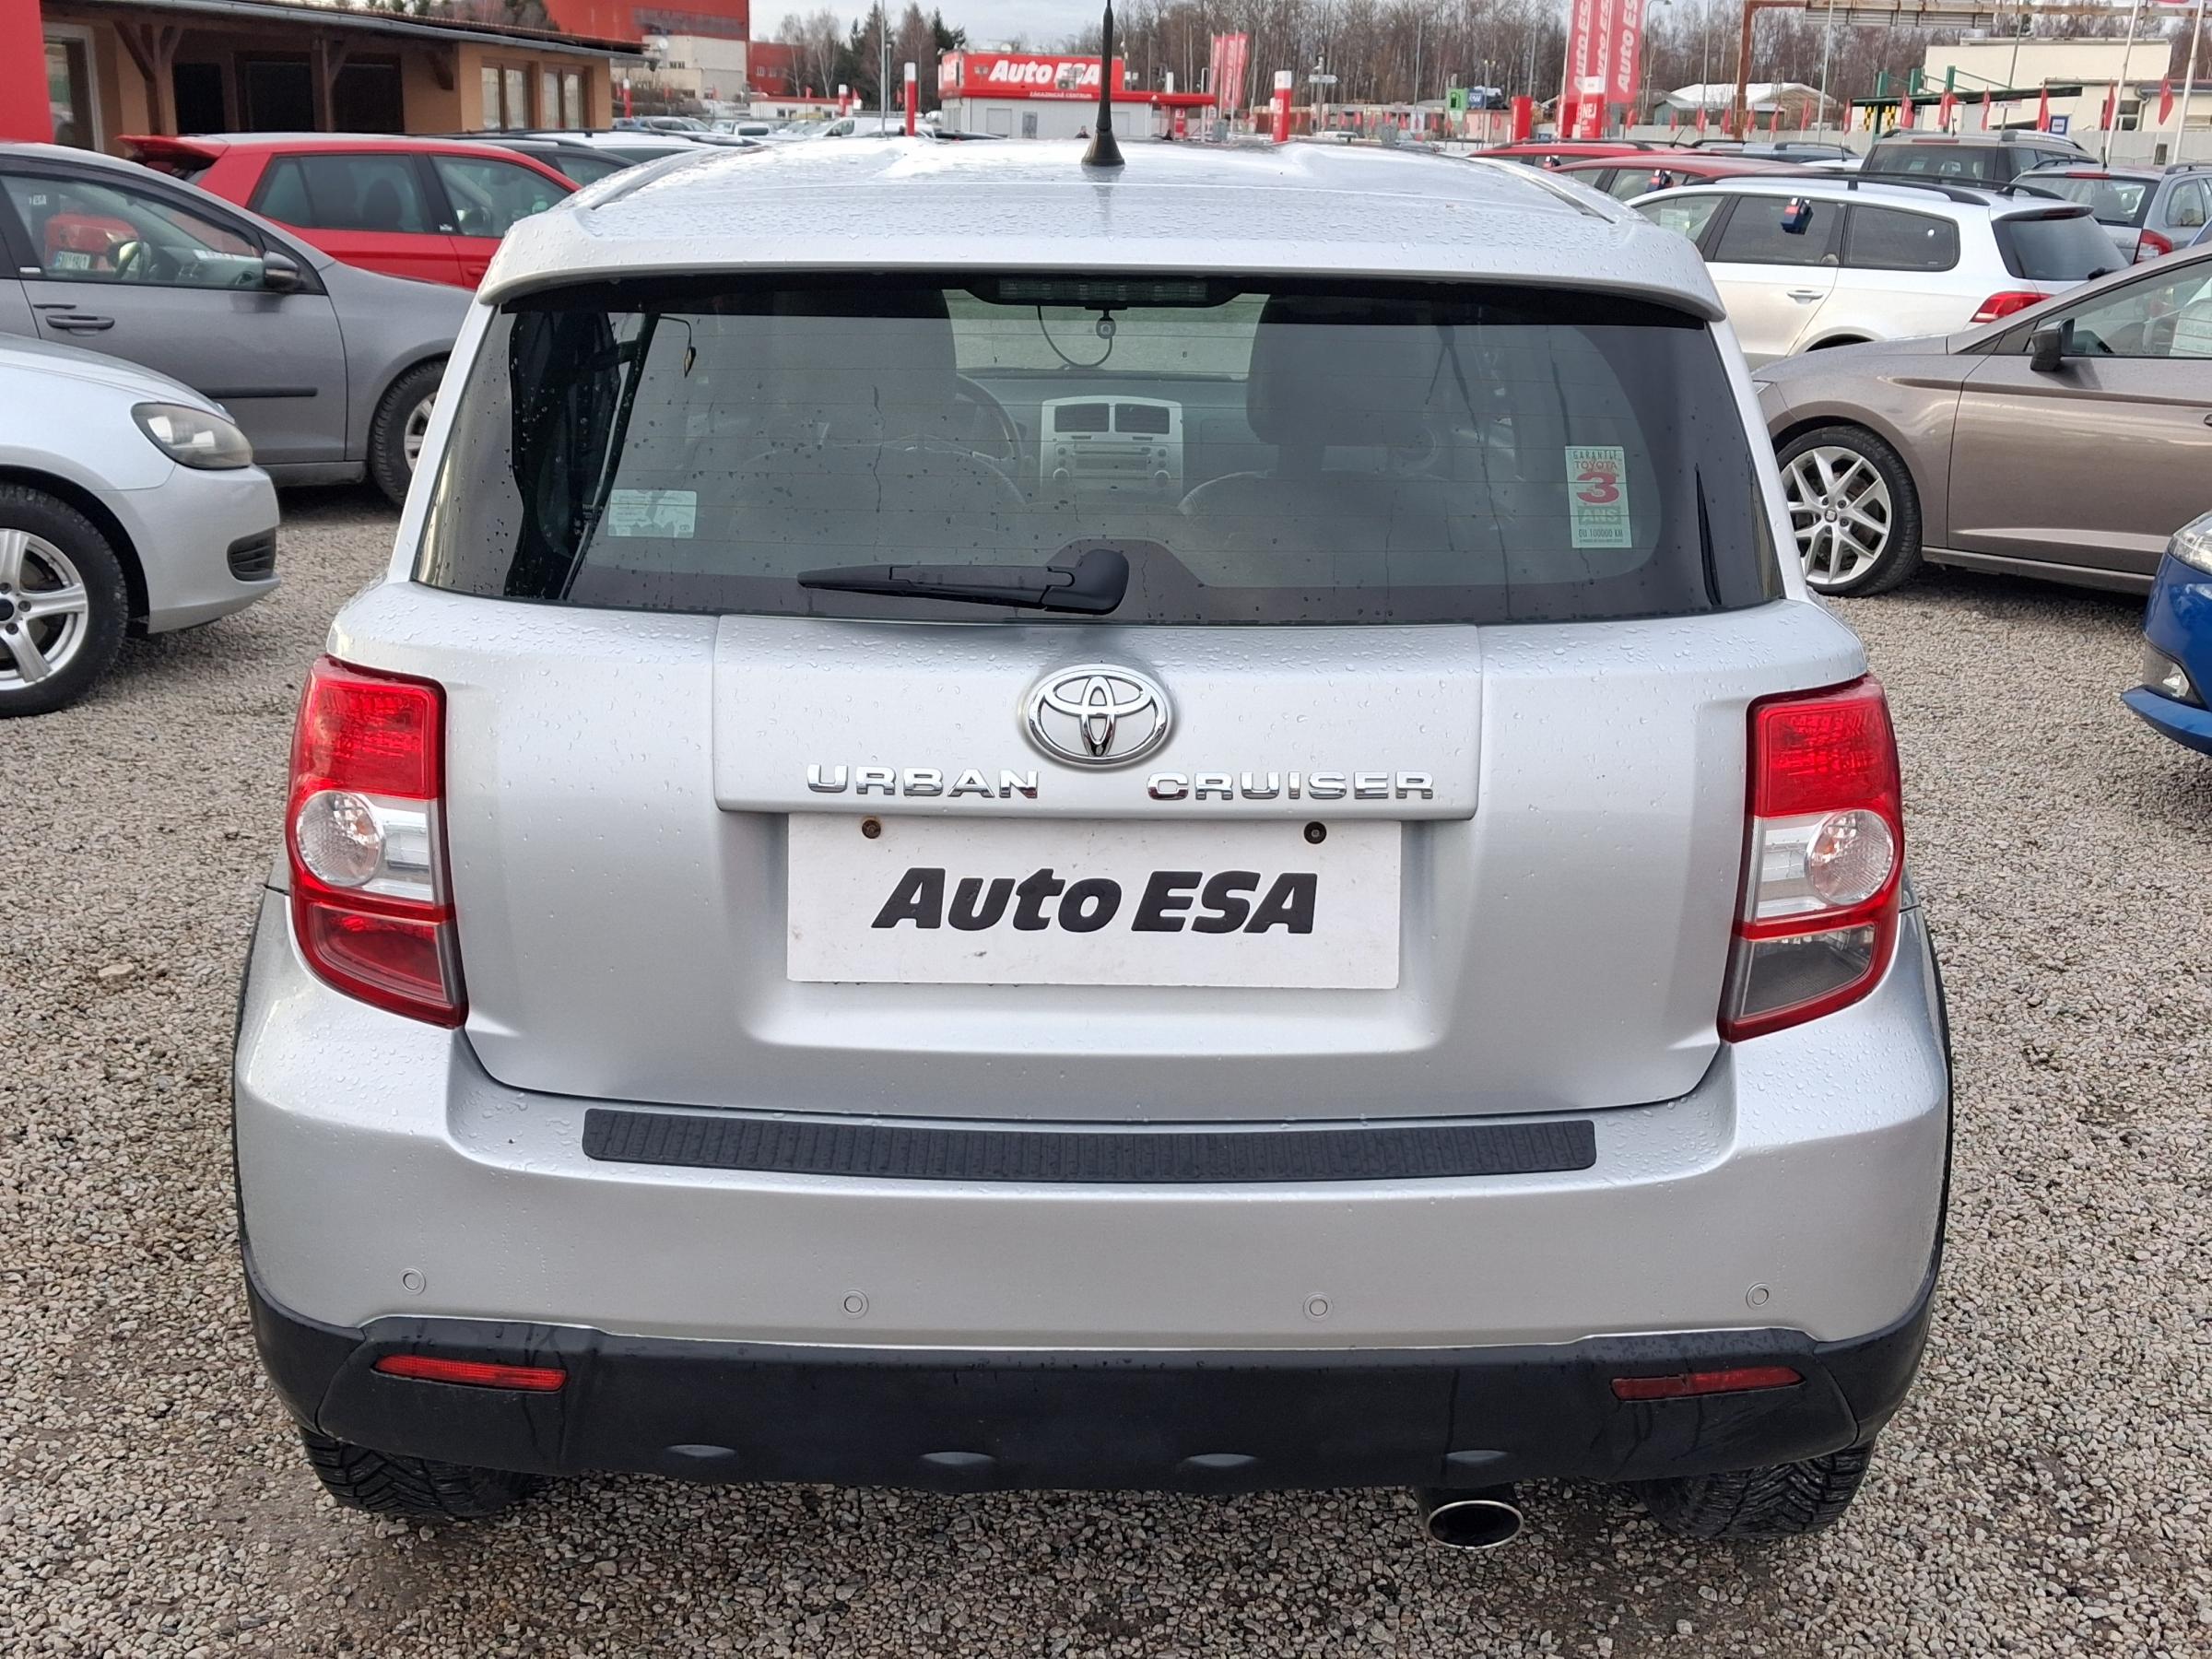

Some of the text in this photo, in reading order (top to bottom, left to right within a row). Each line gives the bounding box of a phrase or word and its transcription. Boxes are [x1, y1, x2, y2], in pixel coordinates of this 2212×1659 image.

[1578, 0, 1589, 32] ES
[988, 60, 1053, 84] Auto
[1574, 461, 1618, 471] TOYOTA
[1577, 472, 1619, 503] 3
[1581, 509, 1618, 523] ANS
[806, 763, 1435, 801] URBAN CRUISER
[871, 866, 1320, 935] Auto ESA
